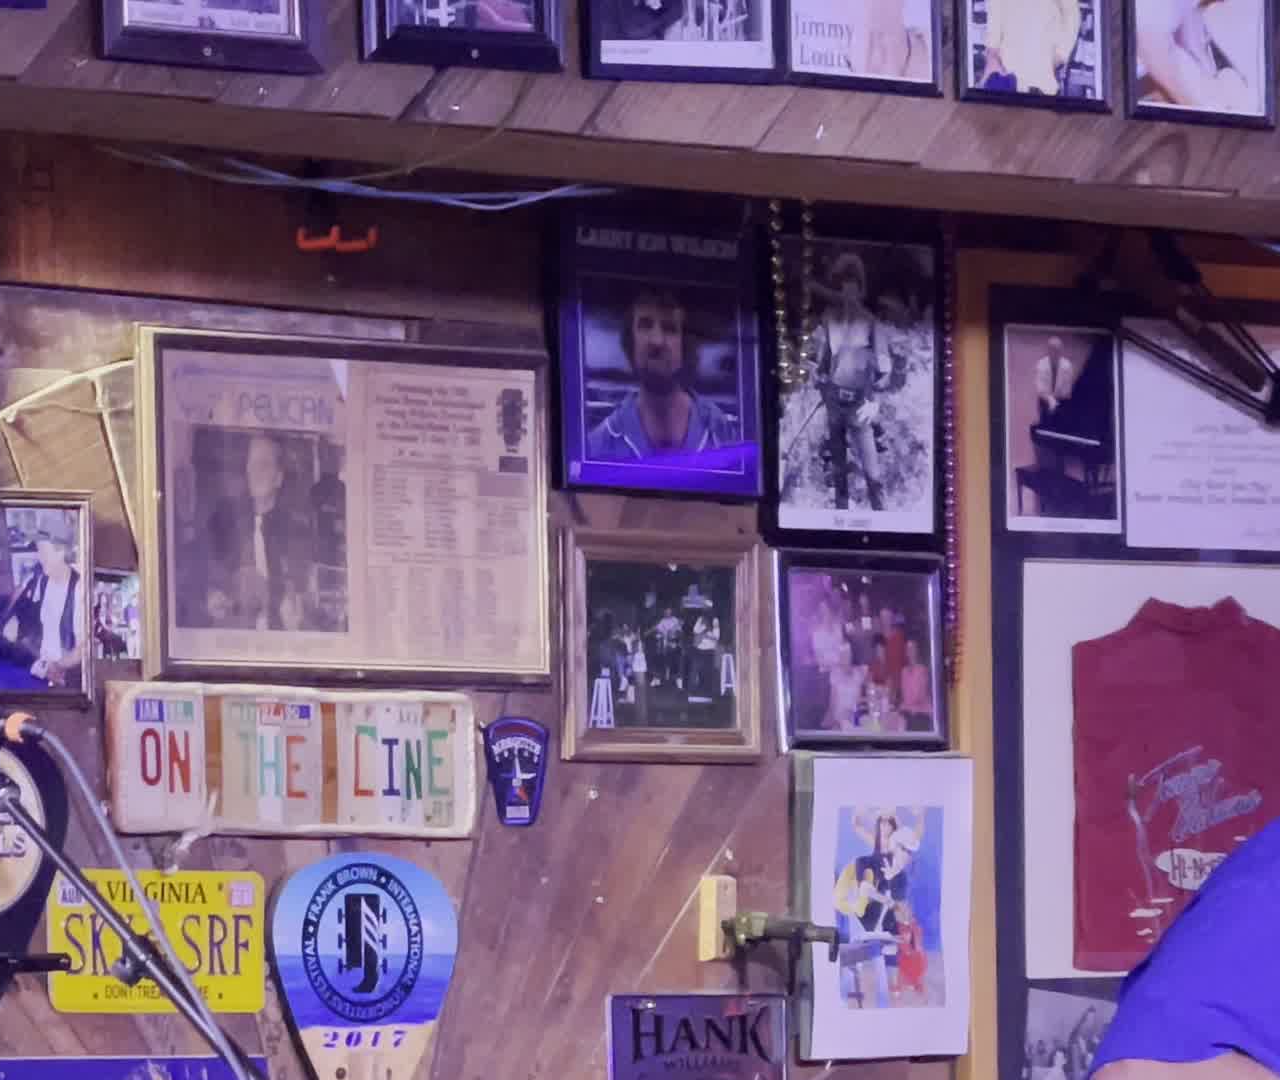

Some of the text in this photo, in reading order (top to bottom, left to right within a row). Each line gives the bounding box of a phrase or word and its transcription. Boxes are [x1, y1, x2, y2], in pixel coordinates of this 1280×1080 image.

[140, 727, 191, 794] ON
[239, 731, 308, 800] THE
[181, 914, 254, 976] SRF
[322, 1030, 407, 1049] 2017
[631, 1004, 773, 1065] HANK
